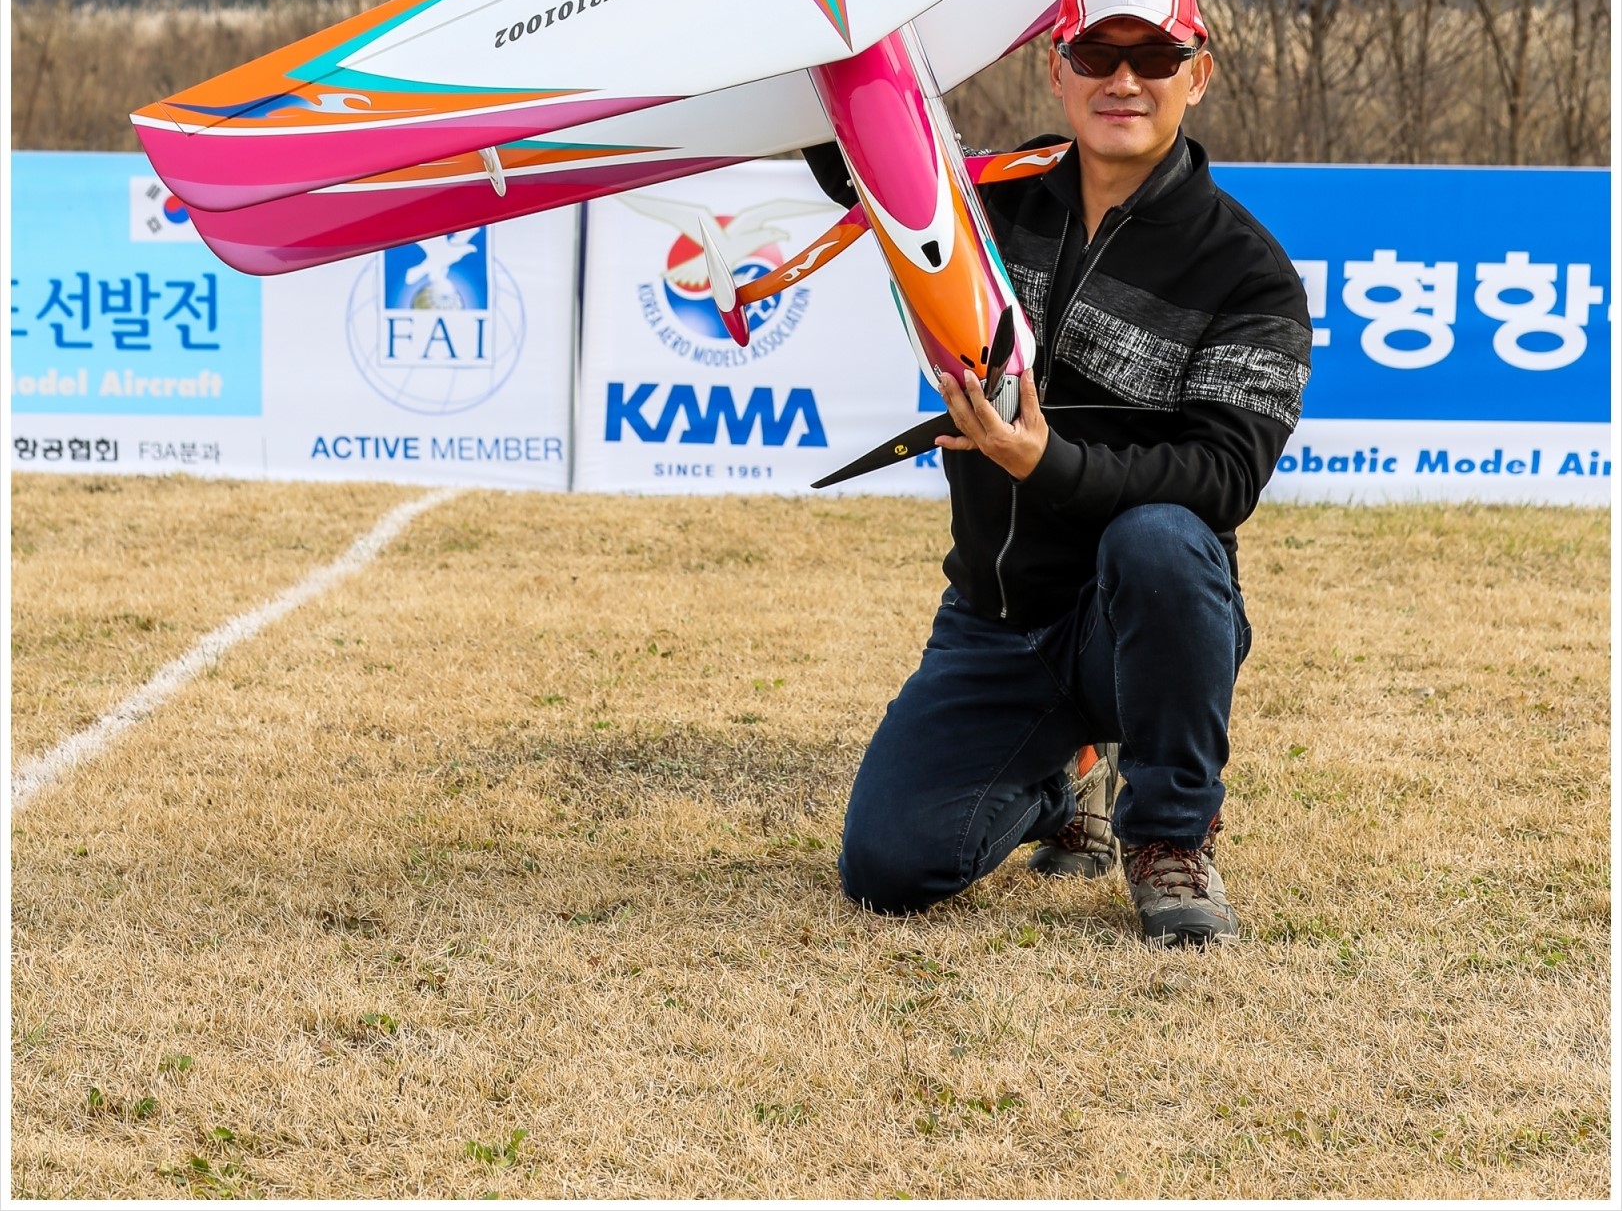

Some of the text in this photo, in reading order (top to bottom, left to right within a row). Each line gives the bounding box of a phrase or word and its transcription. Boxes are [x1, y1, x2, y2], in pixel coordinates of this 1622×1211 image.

[36, 271, 221, 351] 선발전
[638, 283, 811, 368] KOREA AERO MODELS ASSOCIATION
[1290, 249, 1611, 372] 형항
[385, 316, 490, 360] FAI
[99, 369, 223, 397] Aircraft
[604, 382, 829, 448] KAMA
[311, 436, 562, 461] ACTIVE MEMBER
[654, 462, 773, 479] SINCE 1961
[1276, 446, 1397, 473] obatic
[1415, 449, 1541, 475] Model
